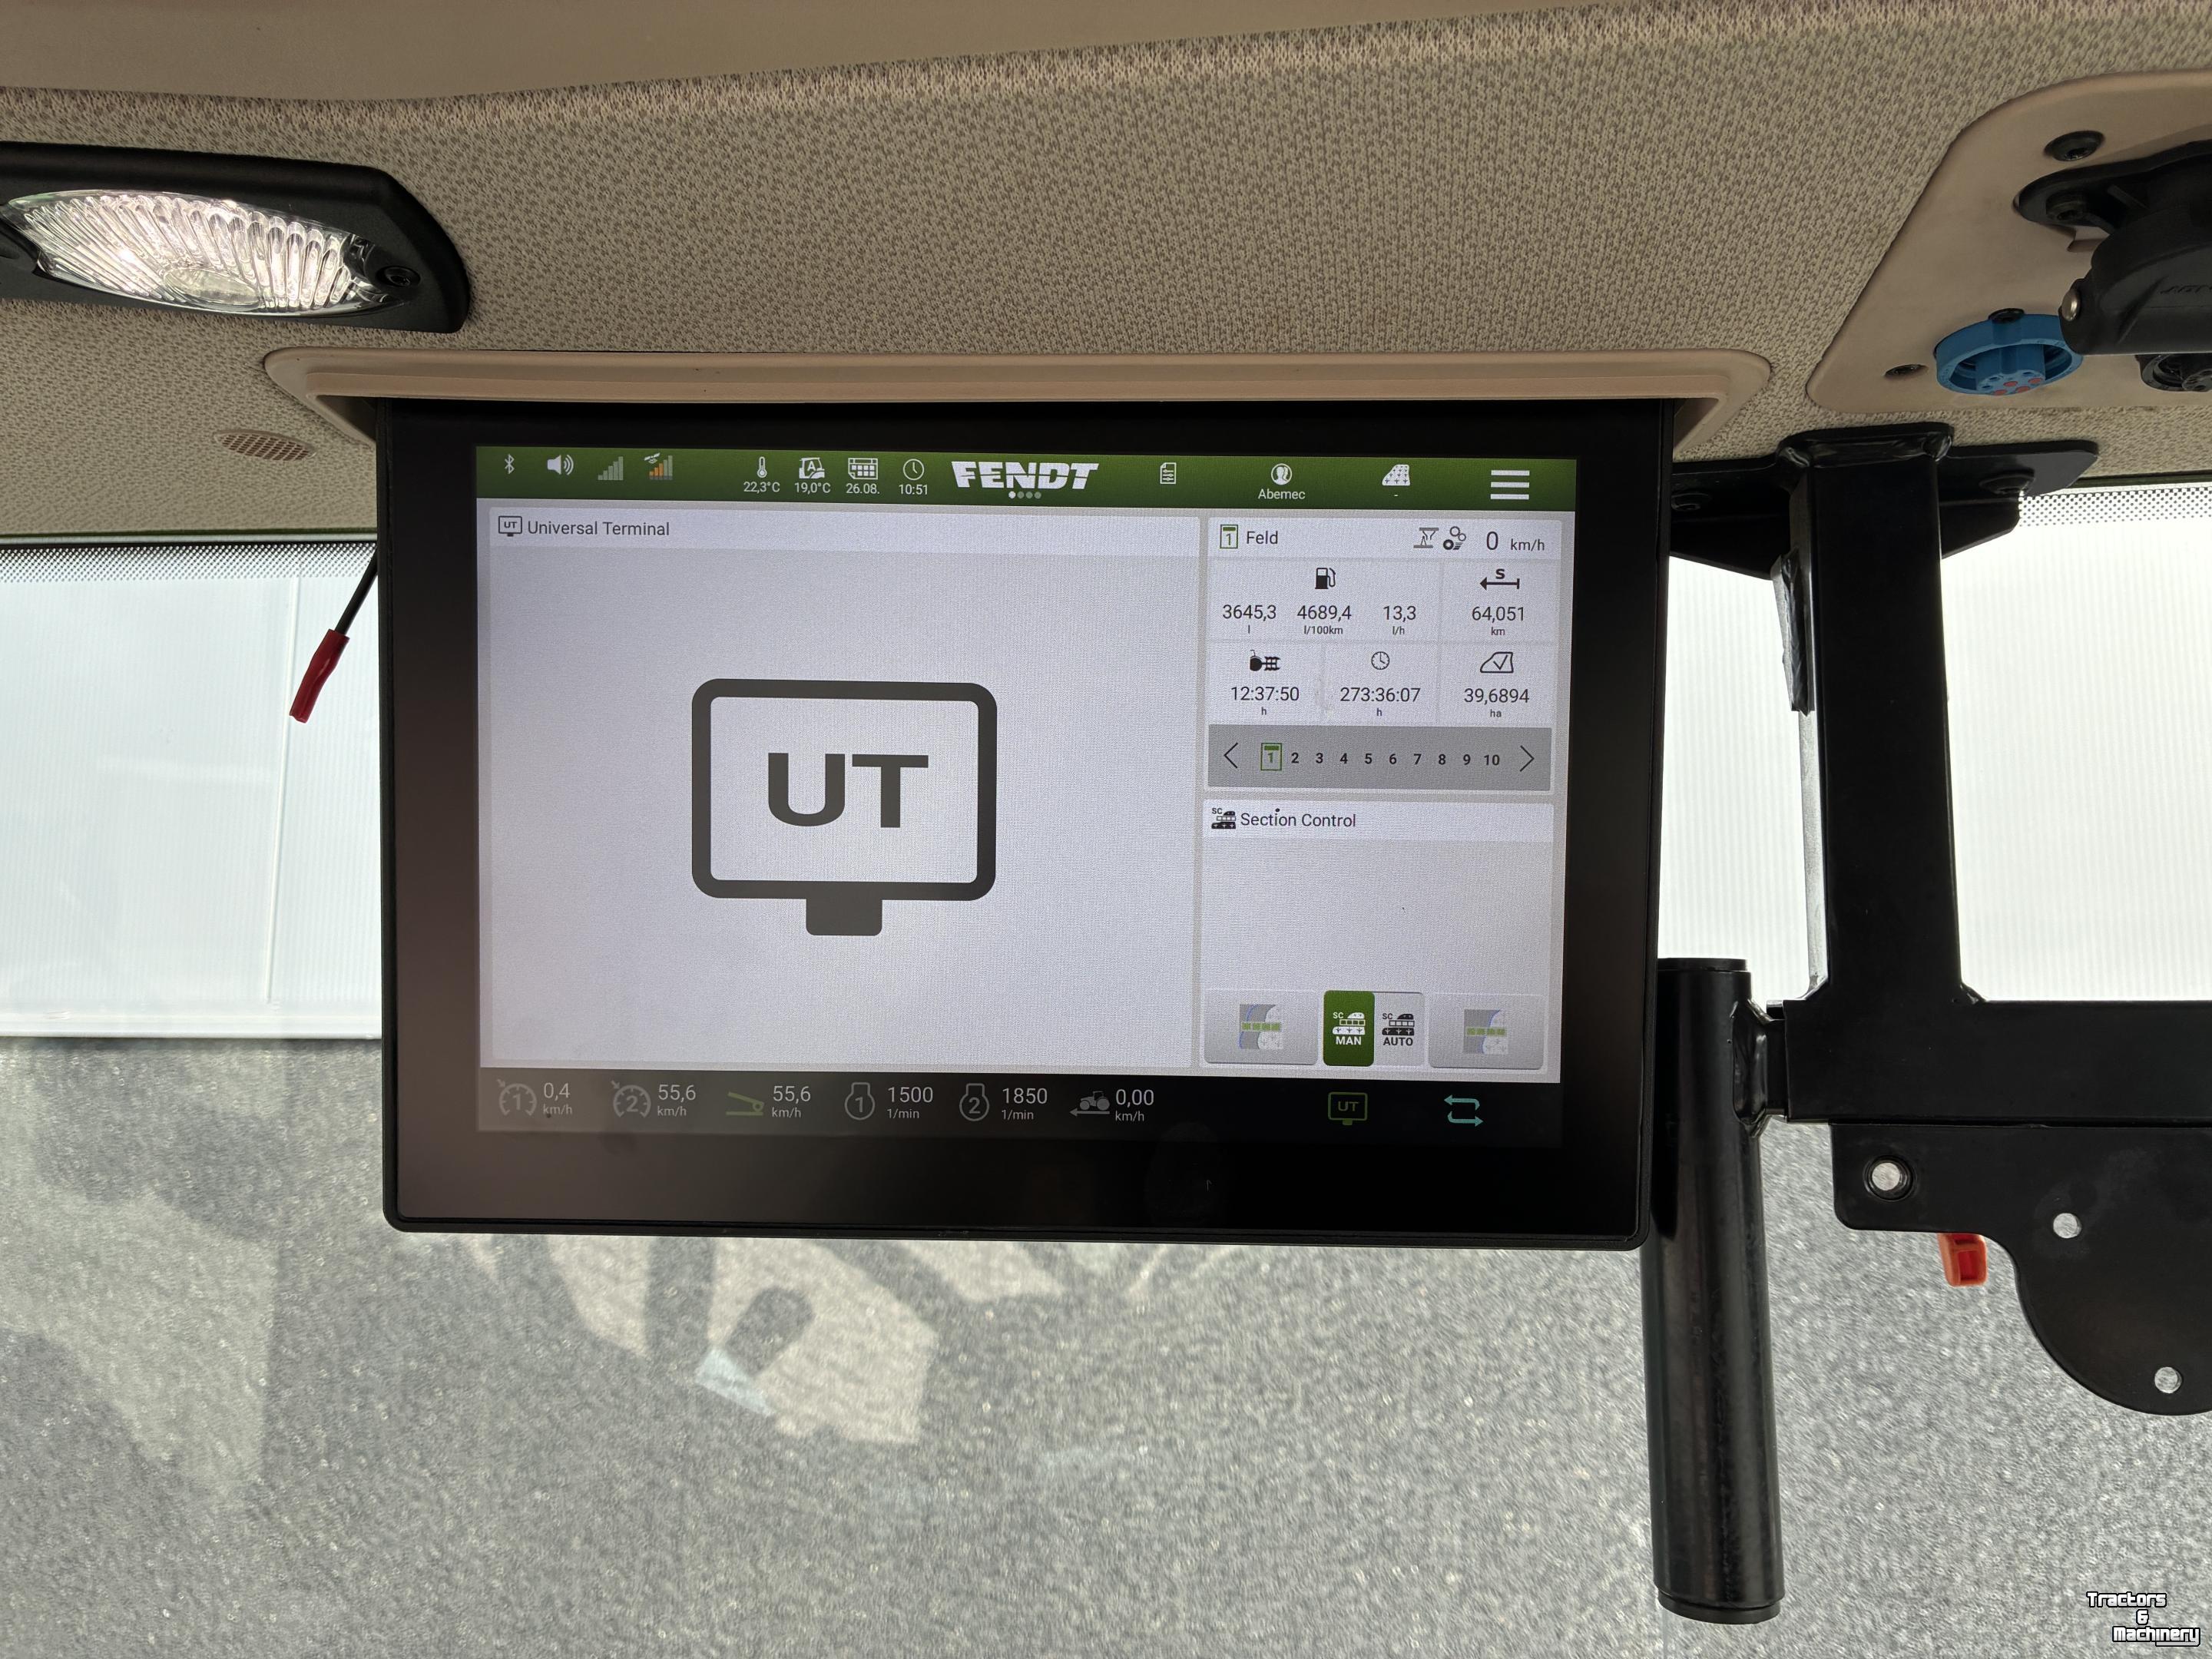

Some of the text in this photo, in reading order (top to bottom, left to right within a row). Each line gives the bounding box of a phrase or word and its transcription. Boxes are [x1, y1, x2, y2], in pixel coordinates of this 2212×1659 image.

[952, 461, 1099, 489] FENDT
[743, 482, 780, 494] 22,3°C
[794, 482, 831, 494] 19,0°C
[846, 482, 880, 495] 26.08.
[899, 484, 929, 495] 10:51
[1257, 488, 1306, 500] Abemec
[504, 521, 518, 529] UT
[527, 521, 670, 536] Universal Terminal
[1246, 531, 1279, 545] Feld
[1486, 531, 1545, 553] 0 km/h
[1222, 604, 1416, 624] 3645,3 4689,4 13,3
[1472, 607, 1525, 624] 64,051
[1491, 627, 1505, 636] km
[1230, 686, 1300, 701] 12:37:50
[1340, 687, 1421, 703] 273:36:07
[1463, 688, 1530, 705] 39,6894
[1260, 707, 1267, 716] h
[1376, 708, 1382, 717] h
[1489, 709, 1502, 718] ha
[1267, 752, 1500, 767] 1 2 3 4 5 6 7 8 9 10
[768, 753, 929, 828] UT
[1240, 811, 1356, 828] Section Control
[1335, 1036, 1362, 1046] MAN
[1382, 1037, 1414, 1047] AUTO
[542, 1082, 571, 1101] 0,4
[657, 1084, 697, 1102] 55,6
[772, 1085, 811, 1104] 55,6
[887, 1086, 934, 1103] 1500
[1002, 1088, 1048, 1104] 1850
[1115, 1089, 1154, 1108] 0,00
[512, 1094, 522, 1110] 1
[626, 1095, 639, 1112] 2
[855, 1097, 864, 1113] 1
[969, 1098, 981, 1114] 2
[1337, 1101, 1359, 1112] UT
[542, 1103, 573, 1117] km/h
[657, 1104, 687, 1118] km/h
[772, 1106, 802, 1119] km/h
[887, 1108, 920, 1120] 1/min
[1002, 1108, 1034, 1121] 1/min
[1114, 1110, 1145, 1123] km/h
